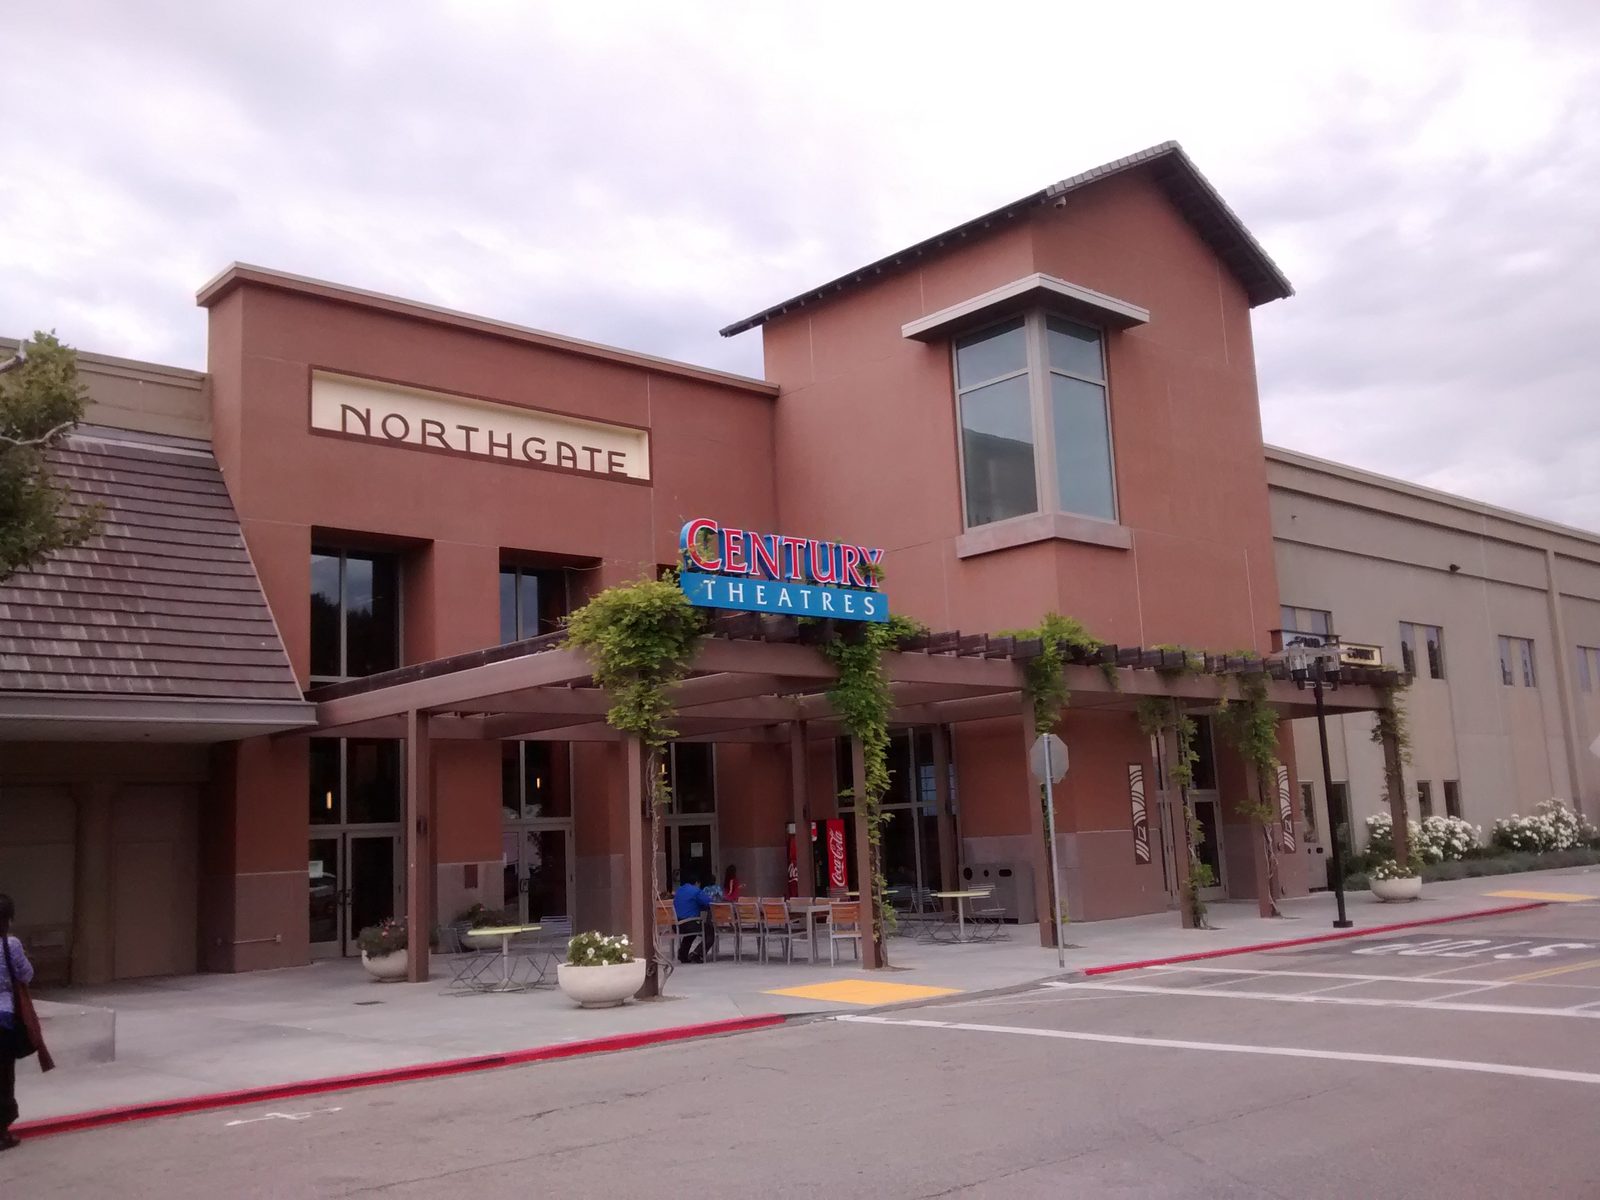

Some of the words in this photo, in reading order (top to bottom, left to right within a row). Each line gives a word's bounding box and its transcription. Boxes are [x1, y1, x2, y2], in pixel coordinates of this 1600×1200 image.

[341, 403, 628, 477] NORTHGATE
[680, 518, 884, 588] CENTURY
[703, 579, 876, 616] THEATRES
